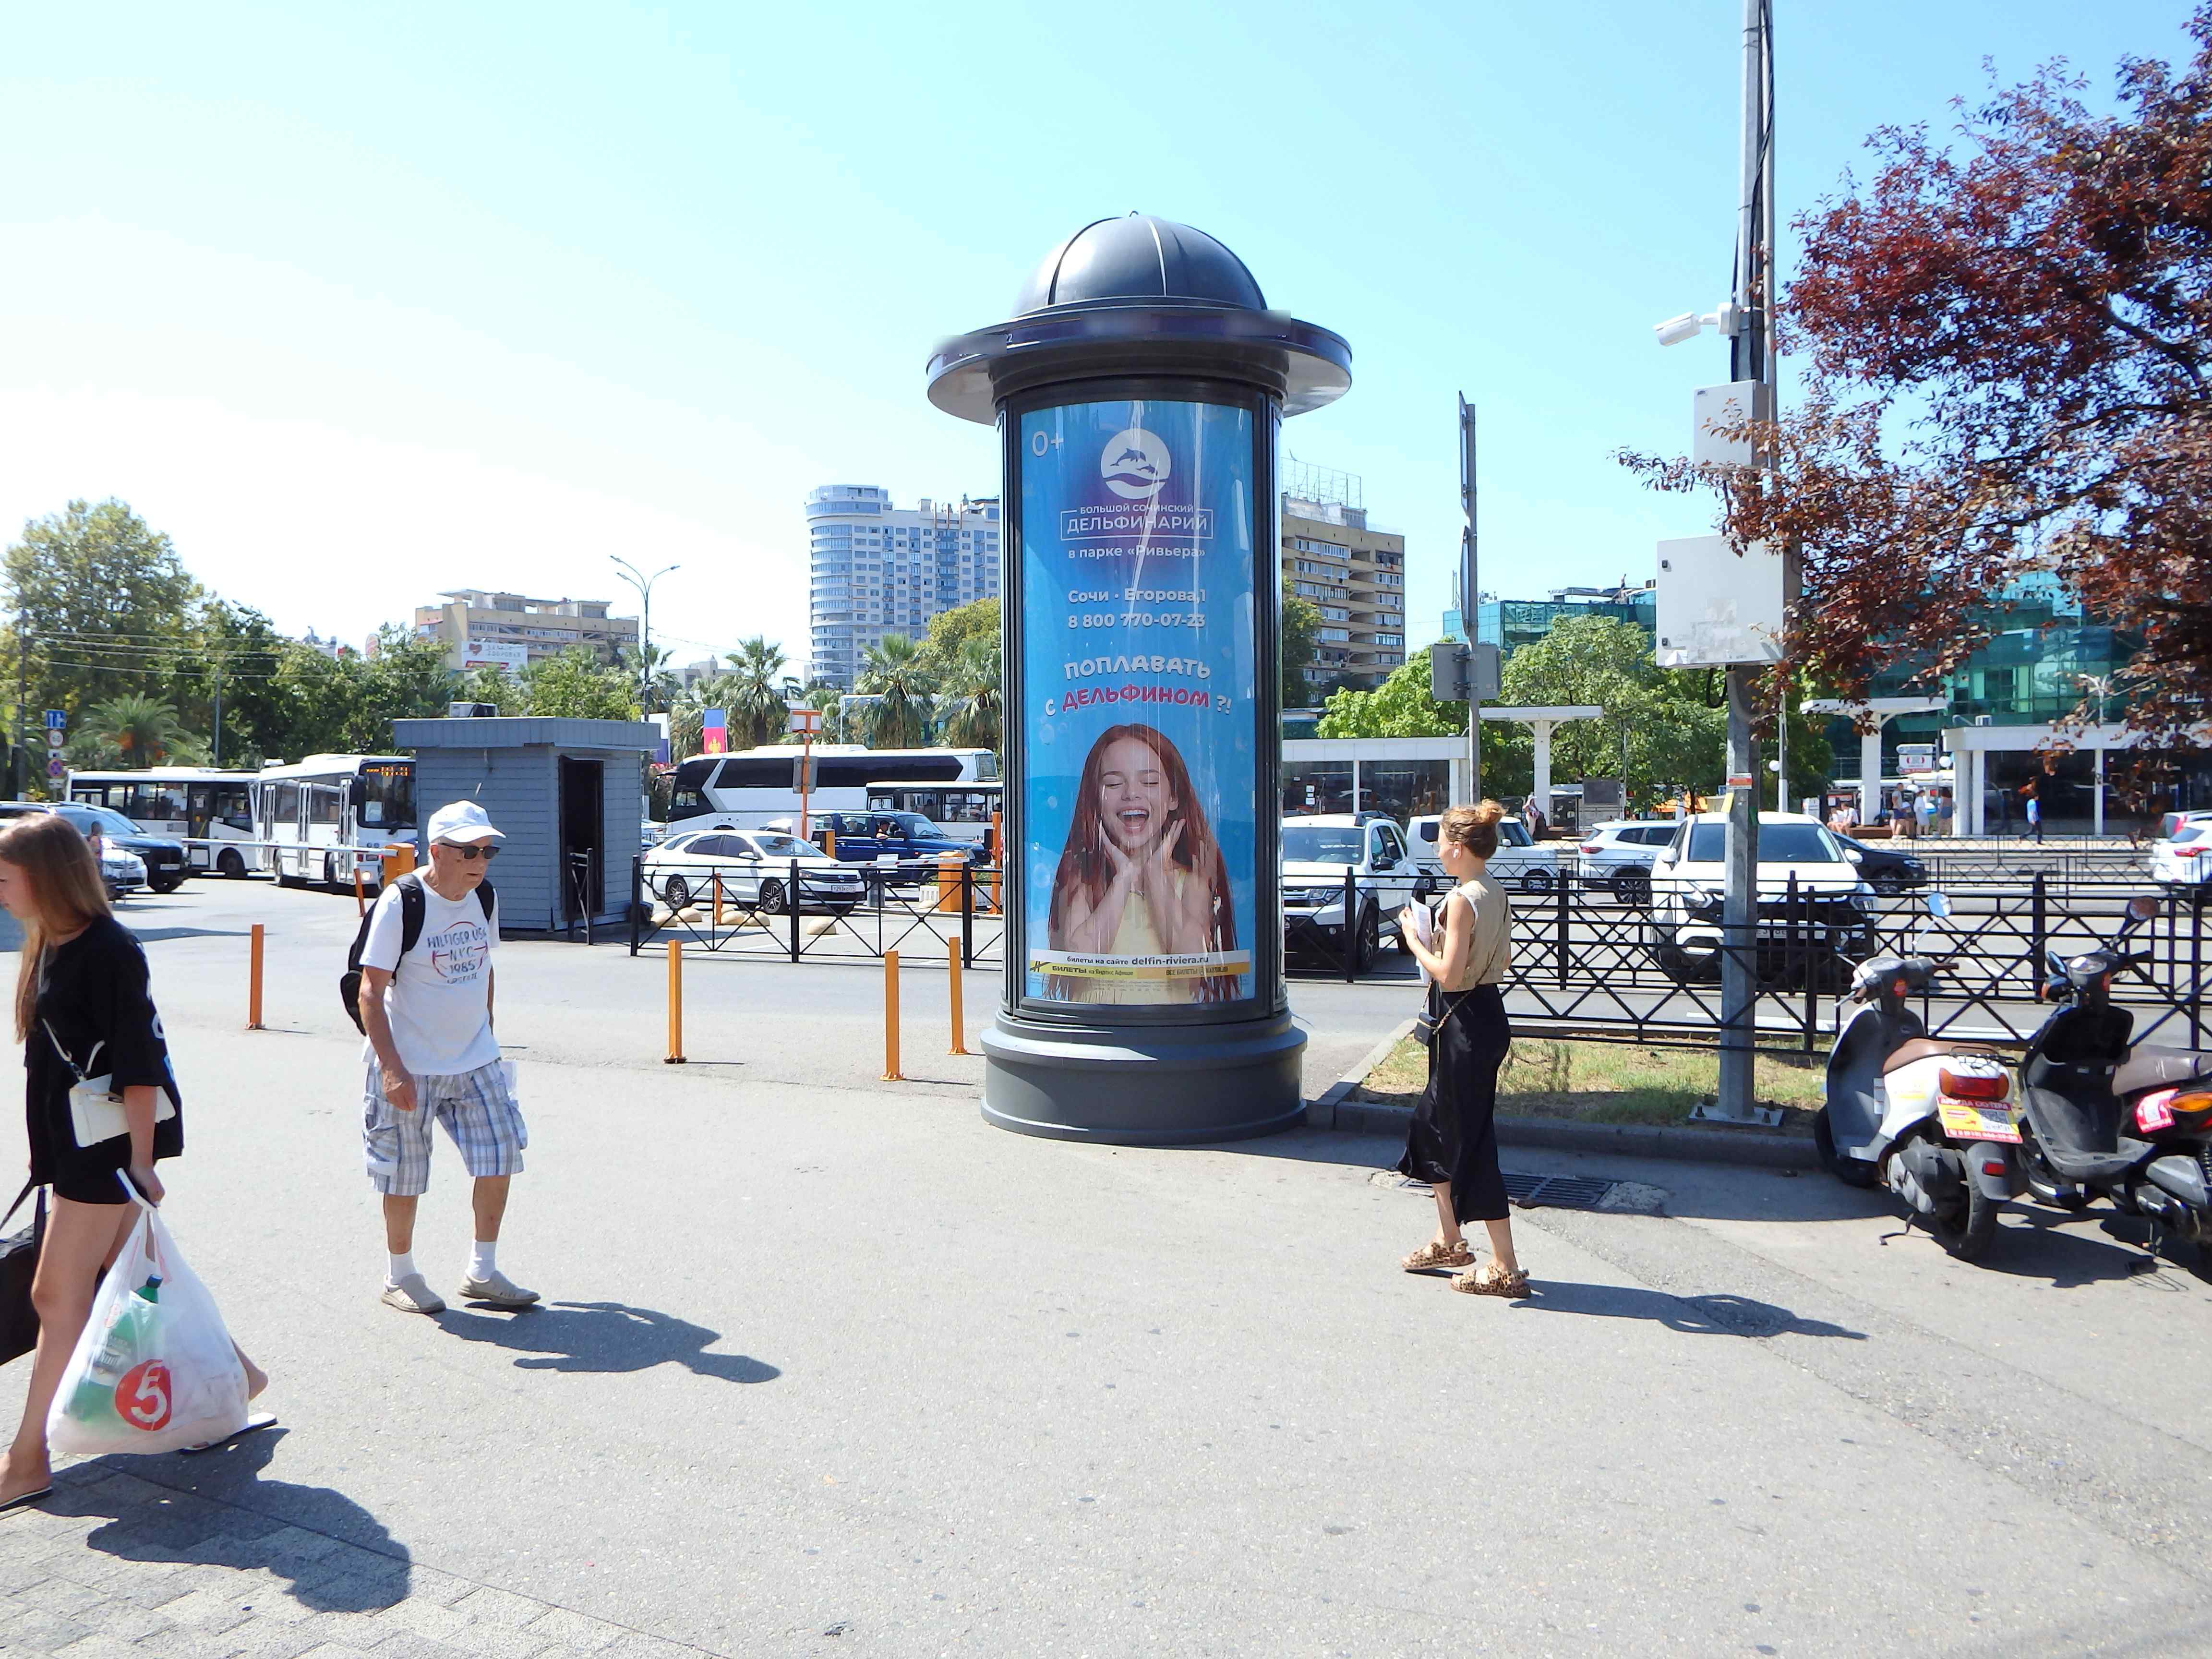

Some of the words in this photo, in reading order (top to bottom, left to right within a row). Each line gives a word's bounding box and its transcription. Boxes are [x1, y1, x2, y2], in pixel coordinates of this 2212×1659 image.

[1032, 431, 1064, 457] 0+
[1080, 503, 1130, 514] БОЛЬШОЙ
[1132, 504, 1193, 513] СОЧИНСКИЙ
[1067, 514, 1207, 534] ДЕЛЬФИНАРИЙ
[1080, 547, 1122, 560] парке
[1128, 545, 1205, 559] «Ривьера»
[1068, 590, 1109, 603] Сочи
[1068, 615, 1078, 628] 8
[1082, 614, 1115, 627] 800
[1120, 613, 1205, 627] 770-07-23
[1064, 655, 1210, 680] ПОПЛАВАТЬ
[1062, 684, 1210, 712] ДЕЛЬФИНОМ
[449, 960, 476, 974] 1985
[1067, 956, 1093, 964] билеты
[1131, 956, 1209, 965] delfin-riviera.ru
[131, 1362, 168, 1423] 5
